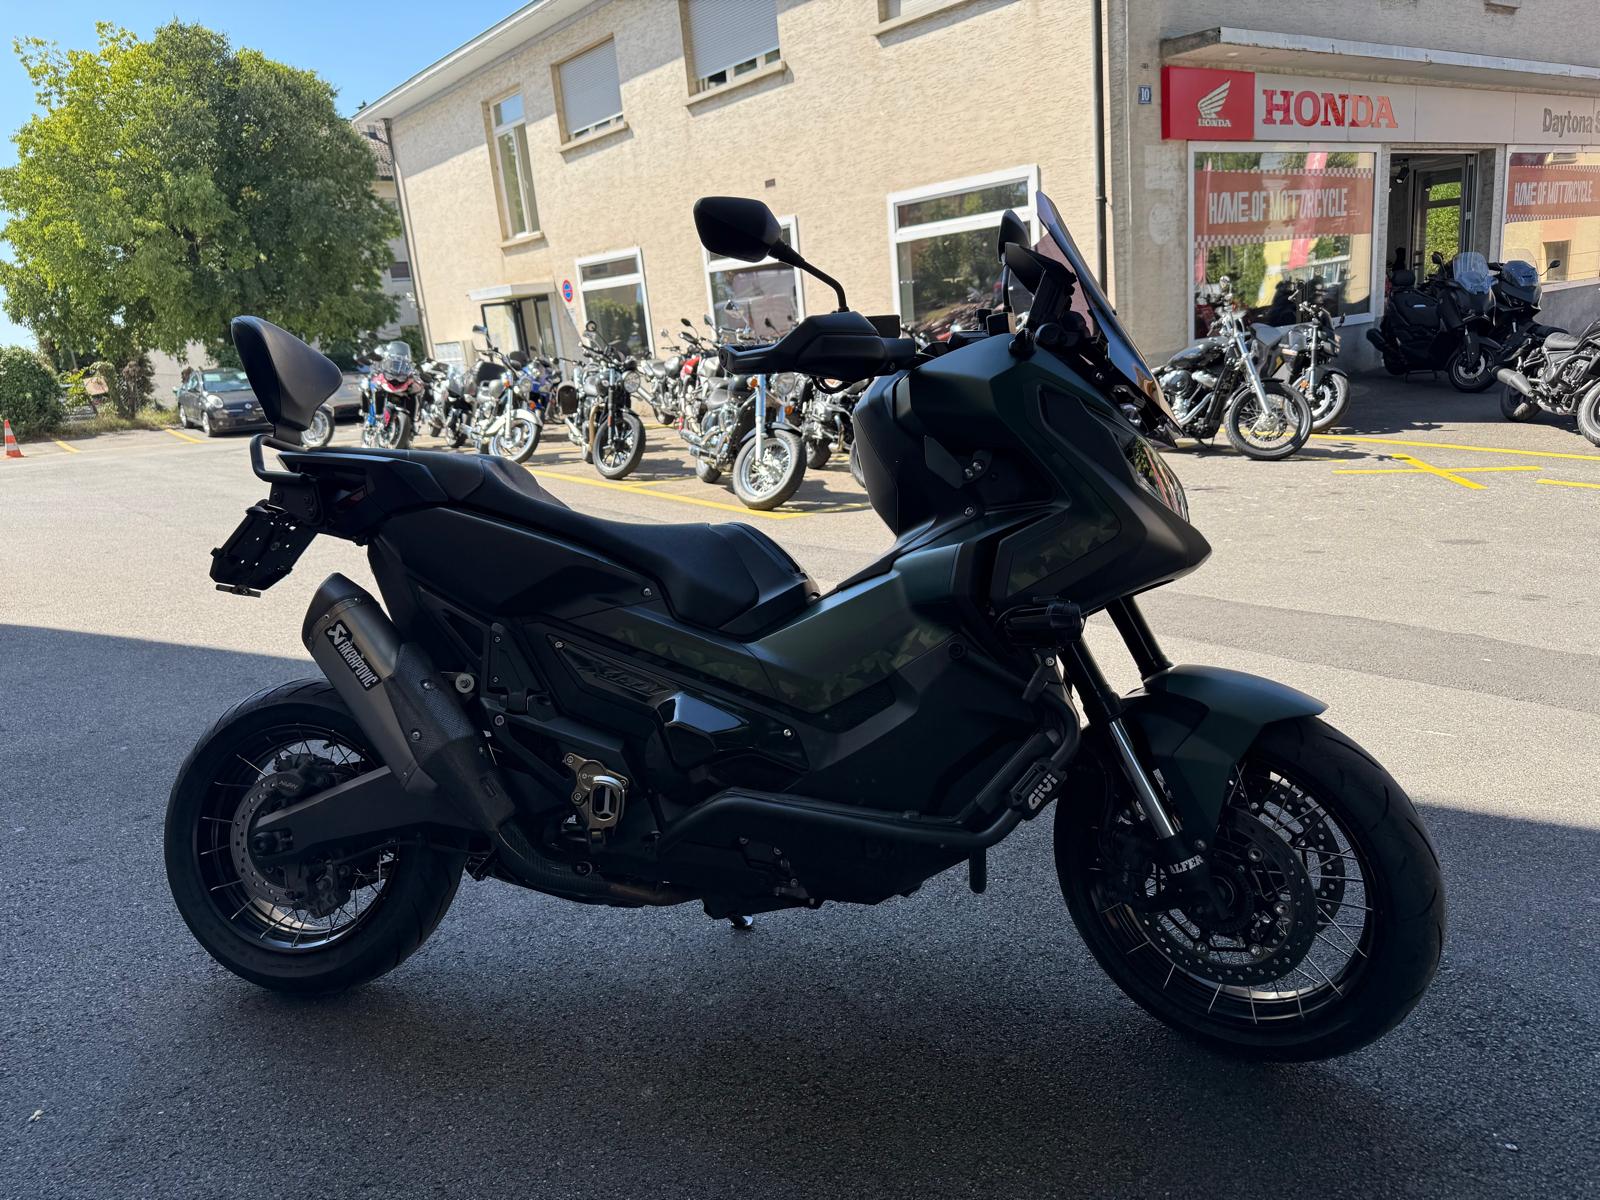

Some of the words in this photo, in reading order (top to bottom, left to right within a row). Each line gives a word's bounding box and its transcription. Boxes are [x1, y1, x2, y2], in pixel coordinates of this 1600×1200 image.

[1141, 87, 1150, 101] 10
[1262, 88, 1399, 129] HONDA
[1198, 118, 1232, 128] HONDA
[1542, 107, 1593, 138] Daytona
[1208, 191, 1249, 225] HOME
[1251, 190, 1267, 222] OF
[1513, 181, 1537, 206] HOME
[1537, 181, 1547, 205] OF
[1028, 772, 1059, 810] GIVI
